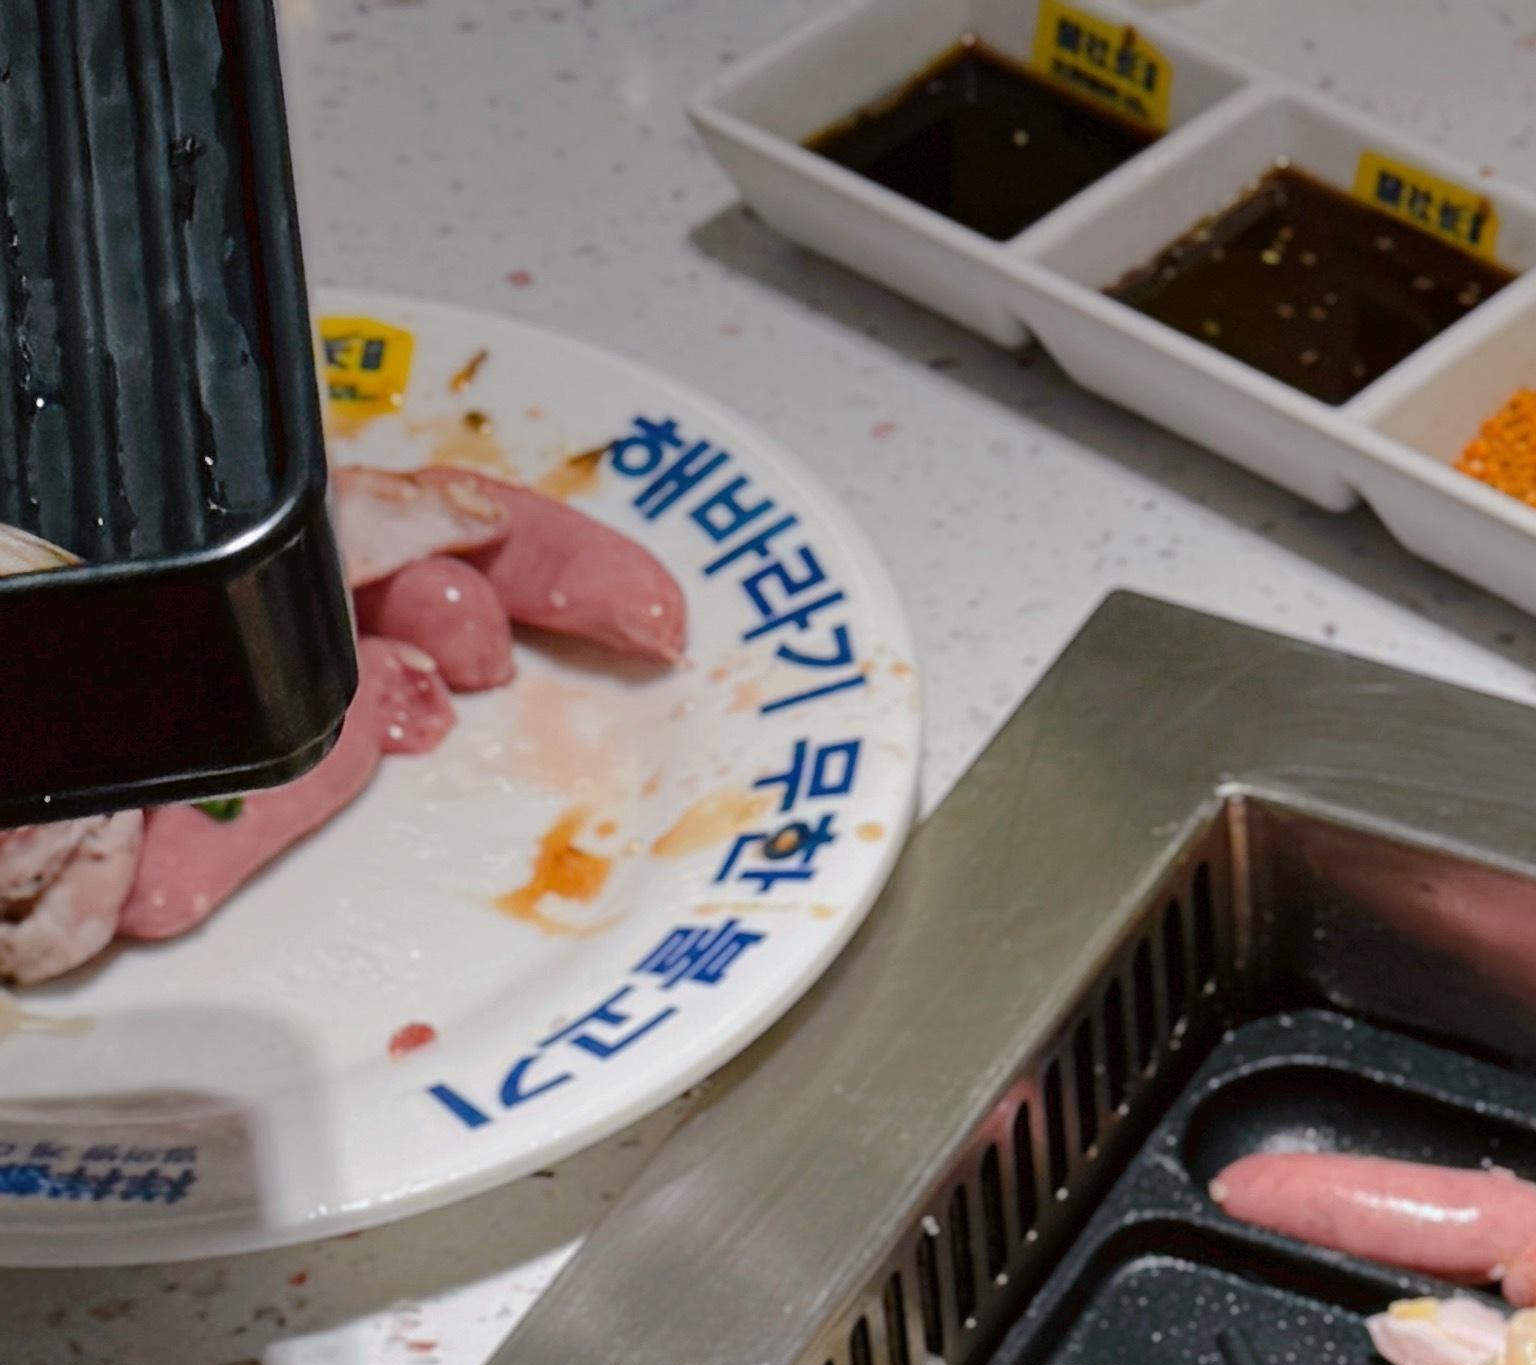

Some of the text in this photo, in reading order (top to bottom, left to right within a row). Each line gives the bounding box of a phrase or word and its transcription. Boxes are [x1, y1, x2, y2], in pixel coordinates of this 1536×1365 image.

[424, 415, 868, 1129] 해바라기 무한 불고기
